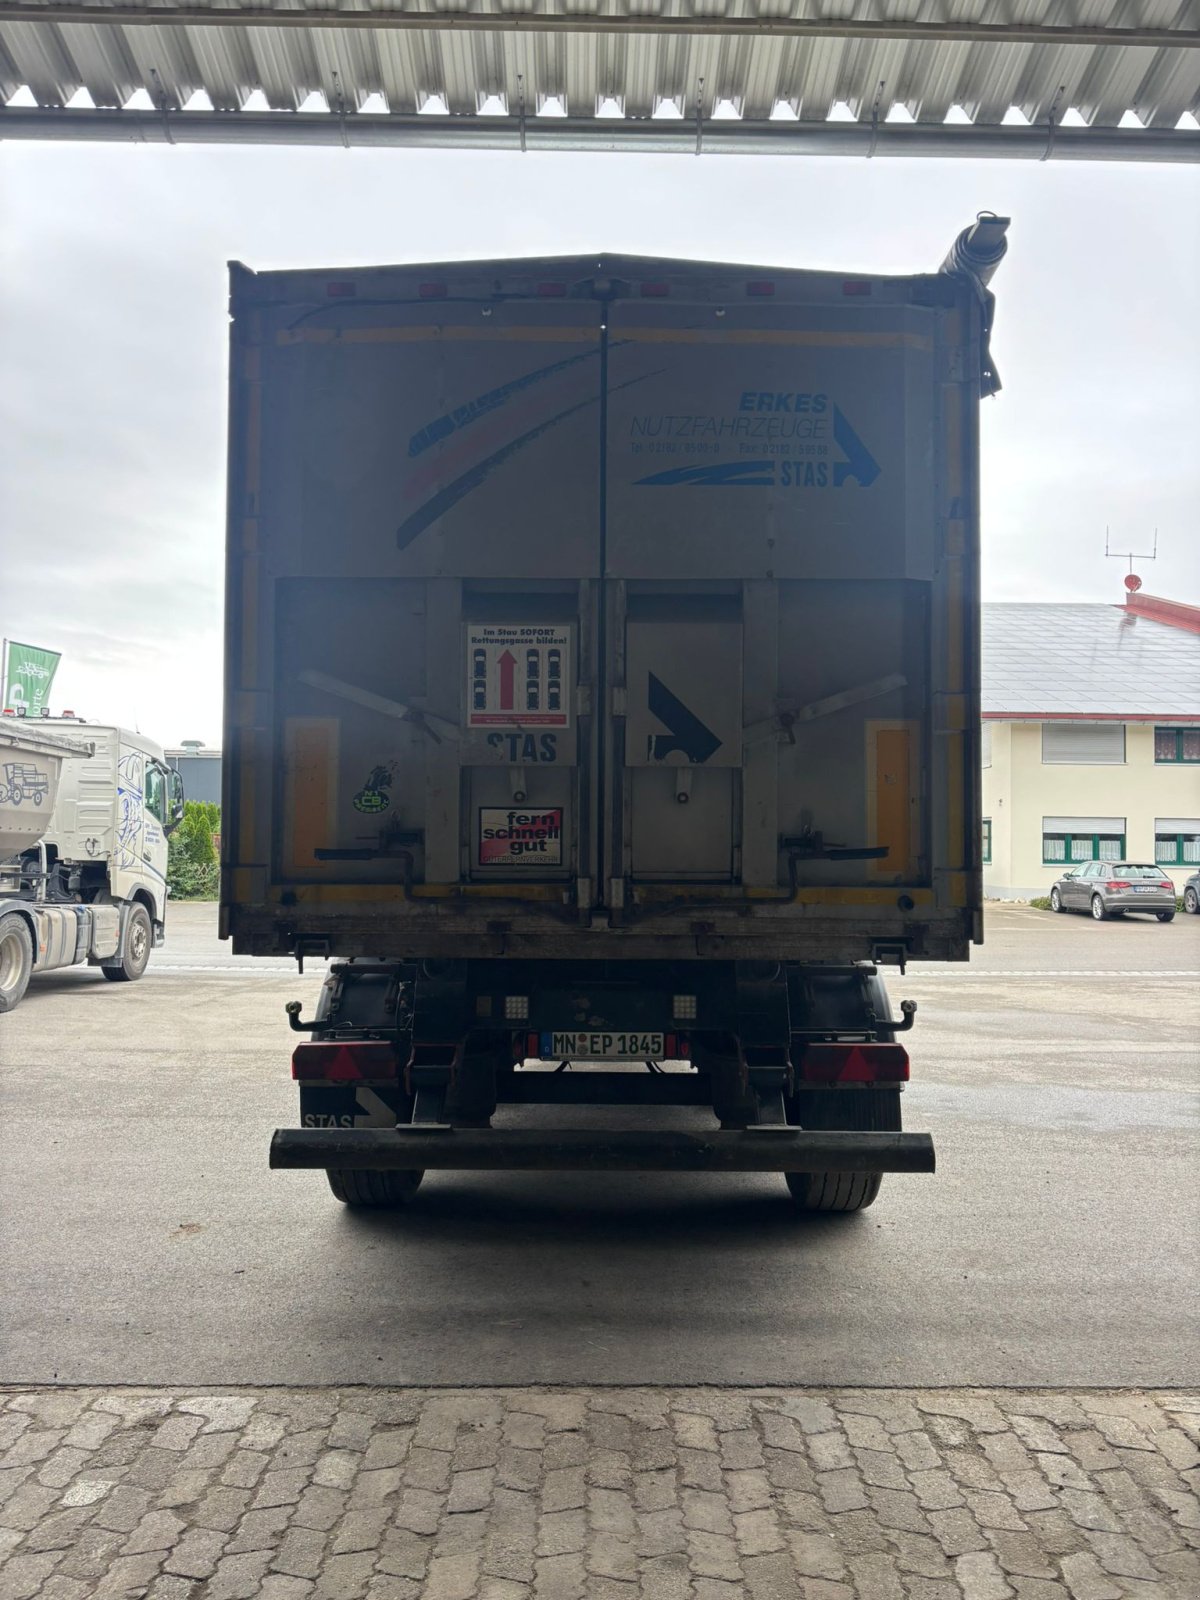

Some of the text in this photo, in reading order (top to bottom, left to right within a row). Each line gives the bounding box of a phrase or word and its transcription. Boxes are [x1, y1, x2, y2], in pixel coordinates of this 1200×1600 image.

[738, 391, 828, 413] ERKES
[630, 416, 828, 438] NUTZFAHRZEUGE
[781, 461, 828, 487] STAS
[483, 628, 555, 636] Im Stau SOFORT
[471, 636, 567, 645] Rettungsgasse bilden!
[362, 796, 381, 805] CB
[507, 811, 555, 825] fern
[483, 826, 559, 839] schnell
[510, 840, 547, 855] gut
[553, 1034, 576, 1054] MN
[590, 1034, 613, 1054] EP
[617, 1034, 662, 1054] 1845
[304, 1113, 352, 1128] STAS
